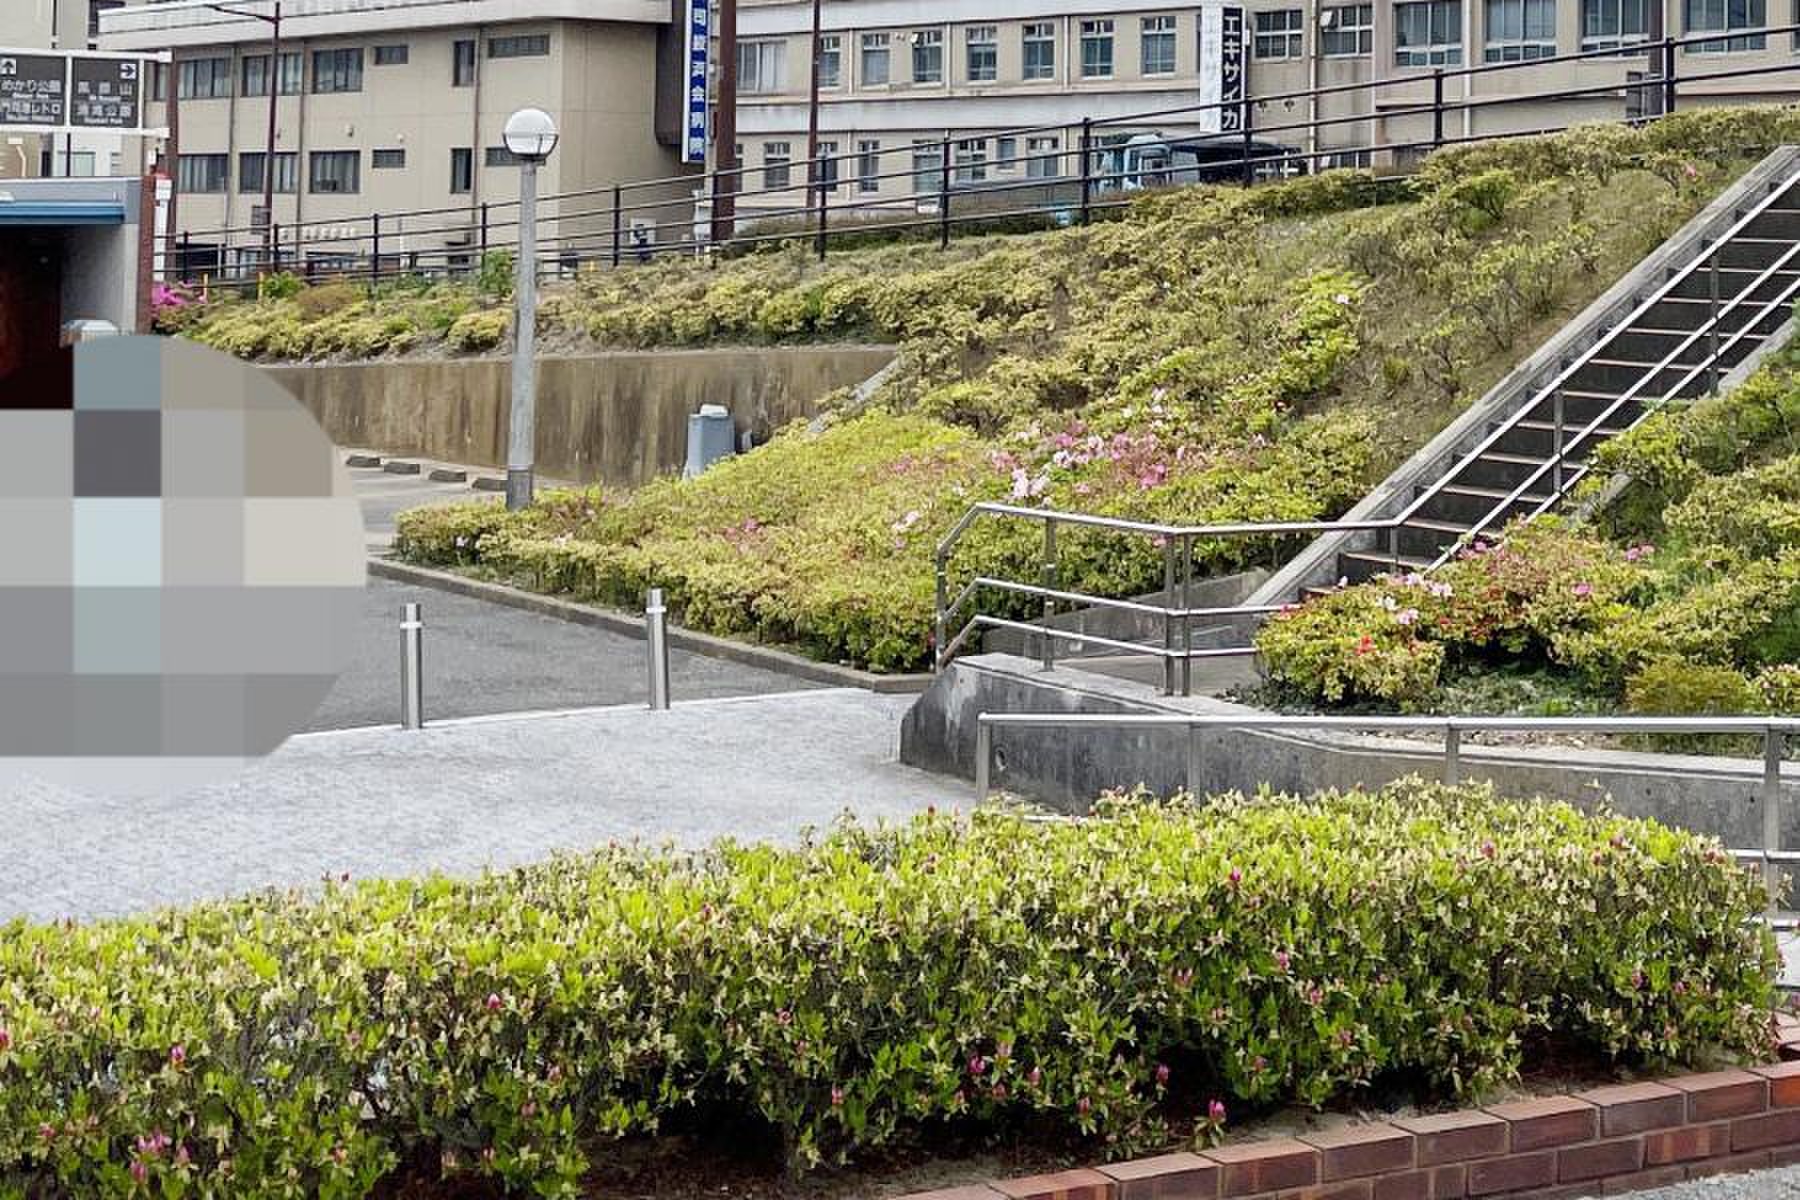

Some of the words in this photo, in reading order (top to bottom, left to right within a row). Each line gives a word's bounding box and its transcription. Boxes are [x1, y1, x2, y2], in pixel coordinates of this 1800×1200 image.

[1223, 16, 1240, 129] エキサイカ
